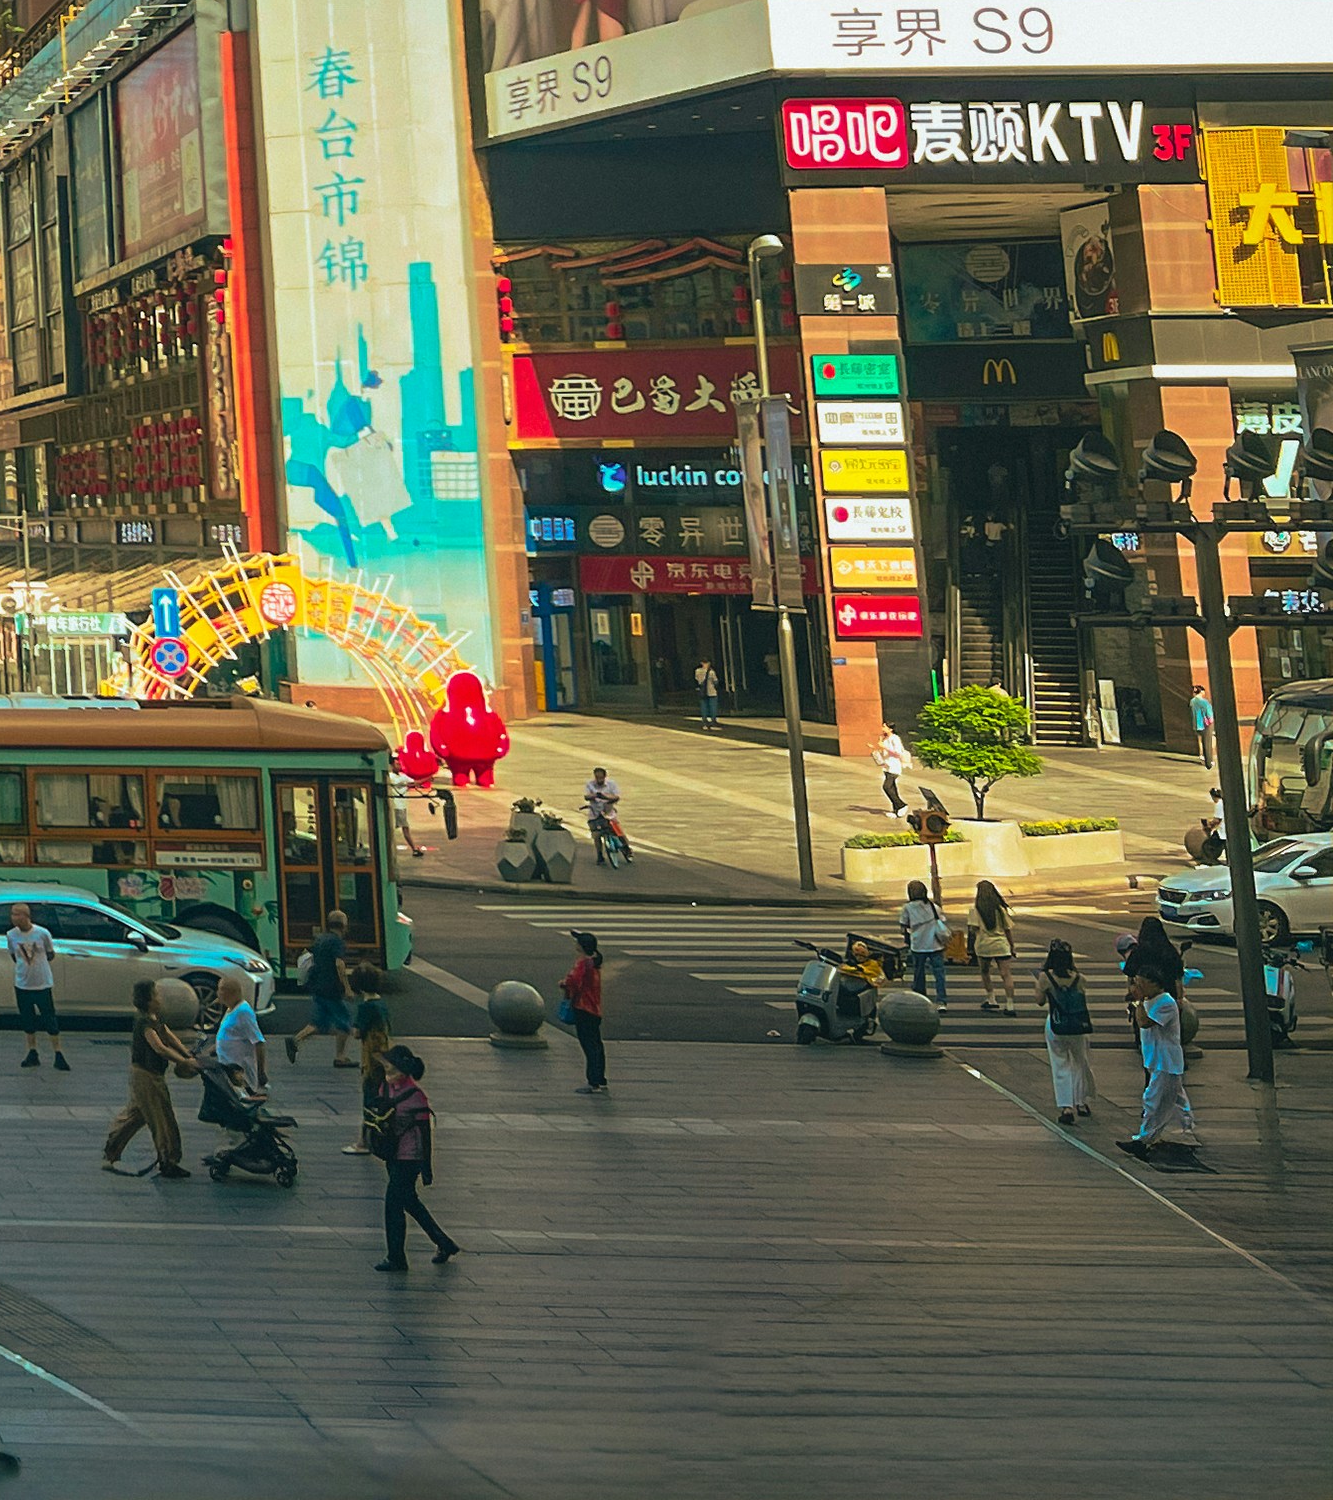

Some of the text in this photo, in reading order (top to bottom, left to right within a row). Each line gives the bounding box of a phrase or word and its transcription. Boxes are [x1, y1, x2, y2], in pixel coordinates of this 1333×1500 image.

[832, 7, 1054, 57] 享界 S9
[506, 55, 614, 119] 享界 S9
[791, 101, 1195, 165] 唱吧 麦颂KTV 3F
[304, 45, 369, 291] 春台市锦
[1239, 182, 1333, 246] 大
[611, 372, 800, 416] 巴蜀大
[1298, 362, 1333, 380] LANCÔ
[636, 465, 708, 486] luckin
[639, 516, 771, 547] 零异世
[666, 562, 806, 580] 京东电竞
